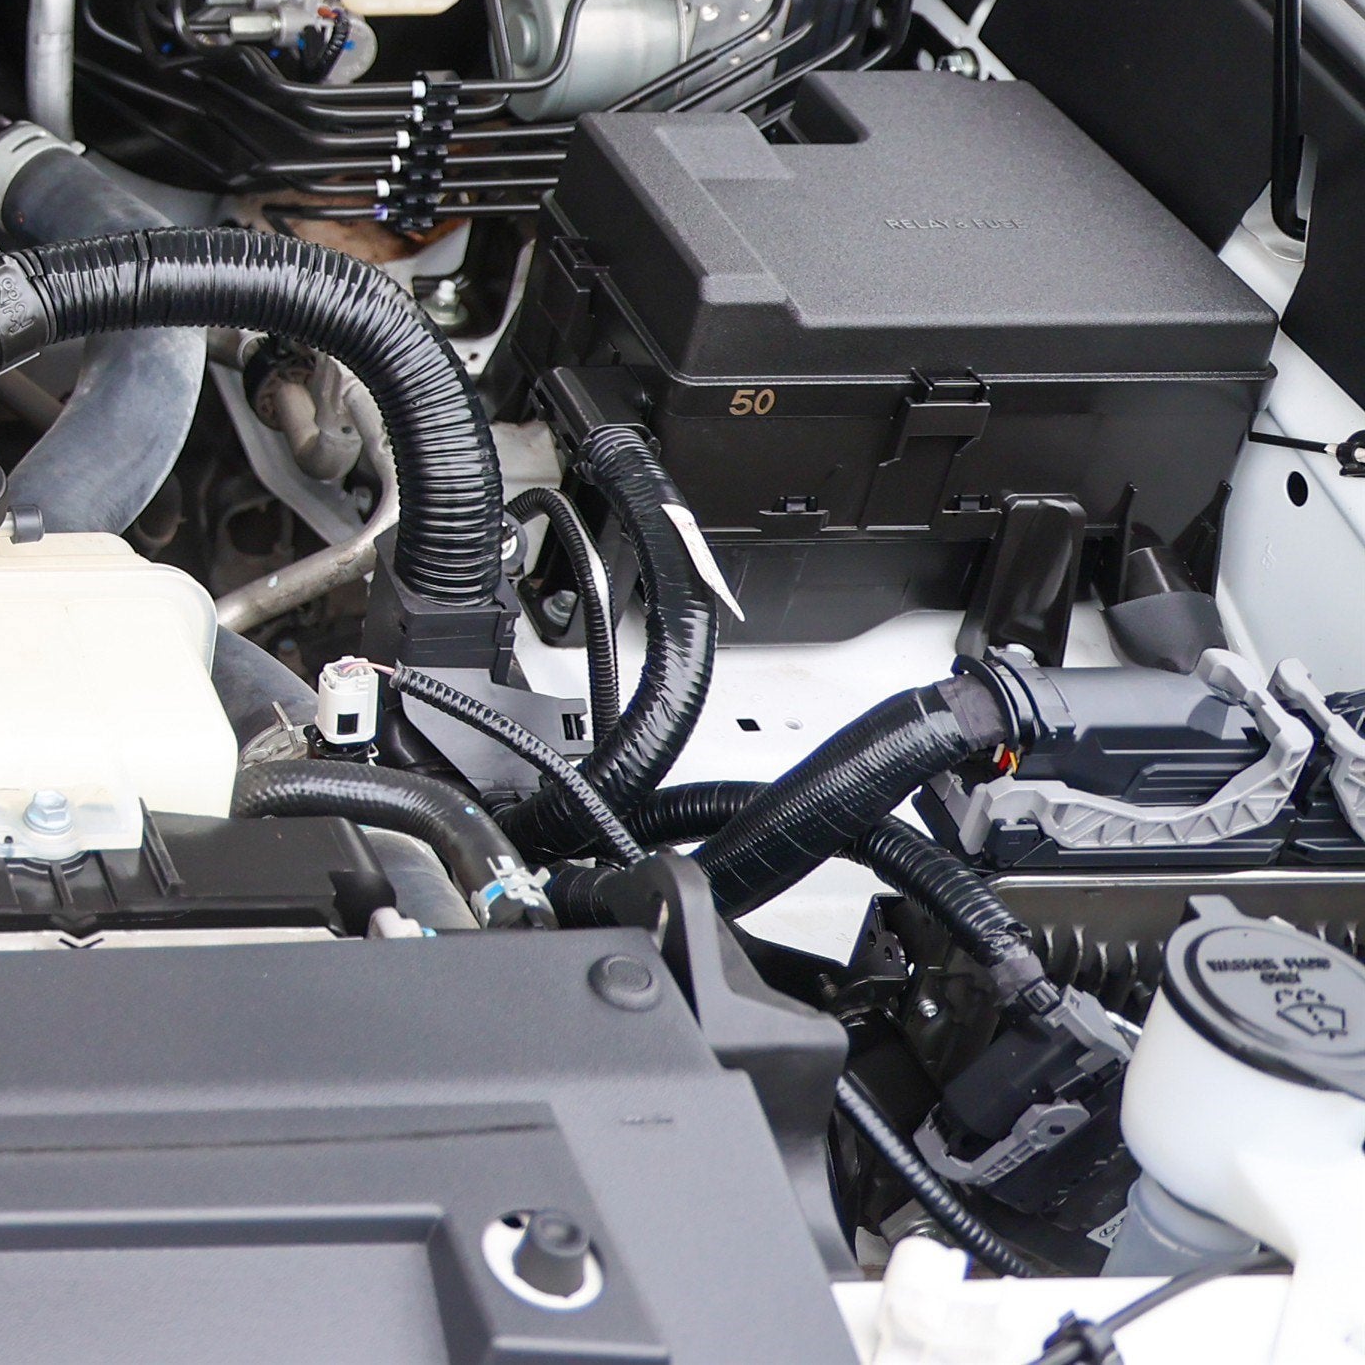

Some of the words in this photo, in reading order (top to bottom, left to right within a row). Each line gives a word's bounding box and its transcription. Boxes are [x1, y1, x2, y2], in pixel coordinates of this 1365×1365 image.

[884, 218, 950, 230] RELAY
[973, 218, 1027, 230] FUSE
[2, 301, 37, 336] 32
[728, 388, 776, 417] 50
